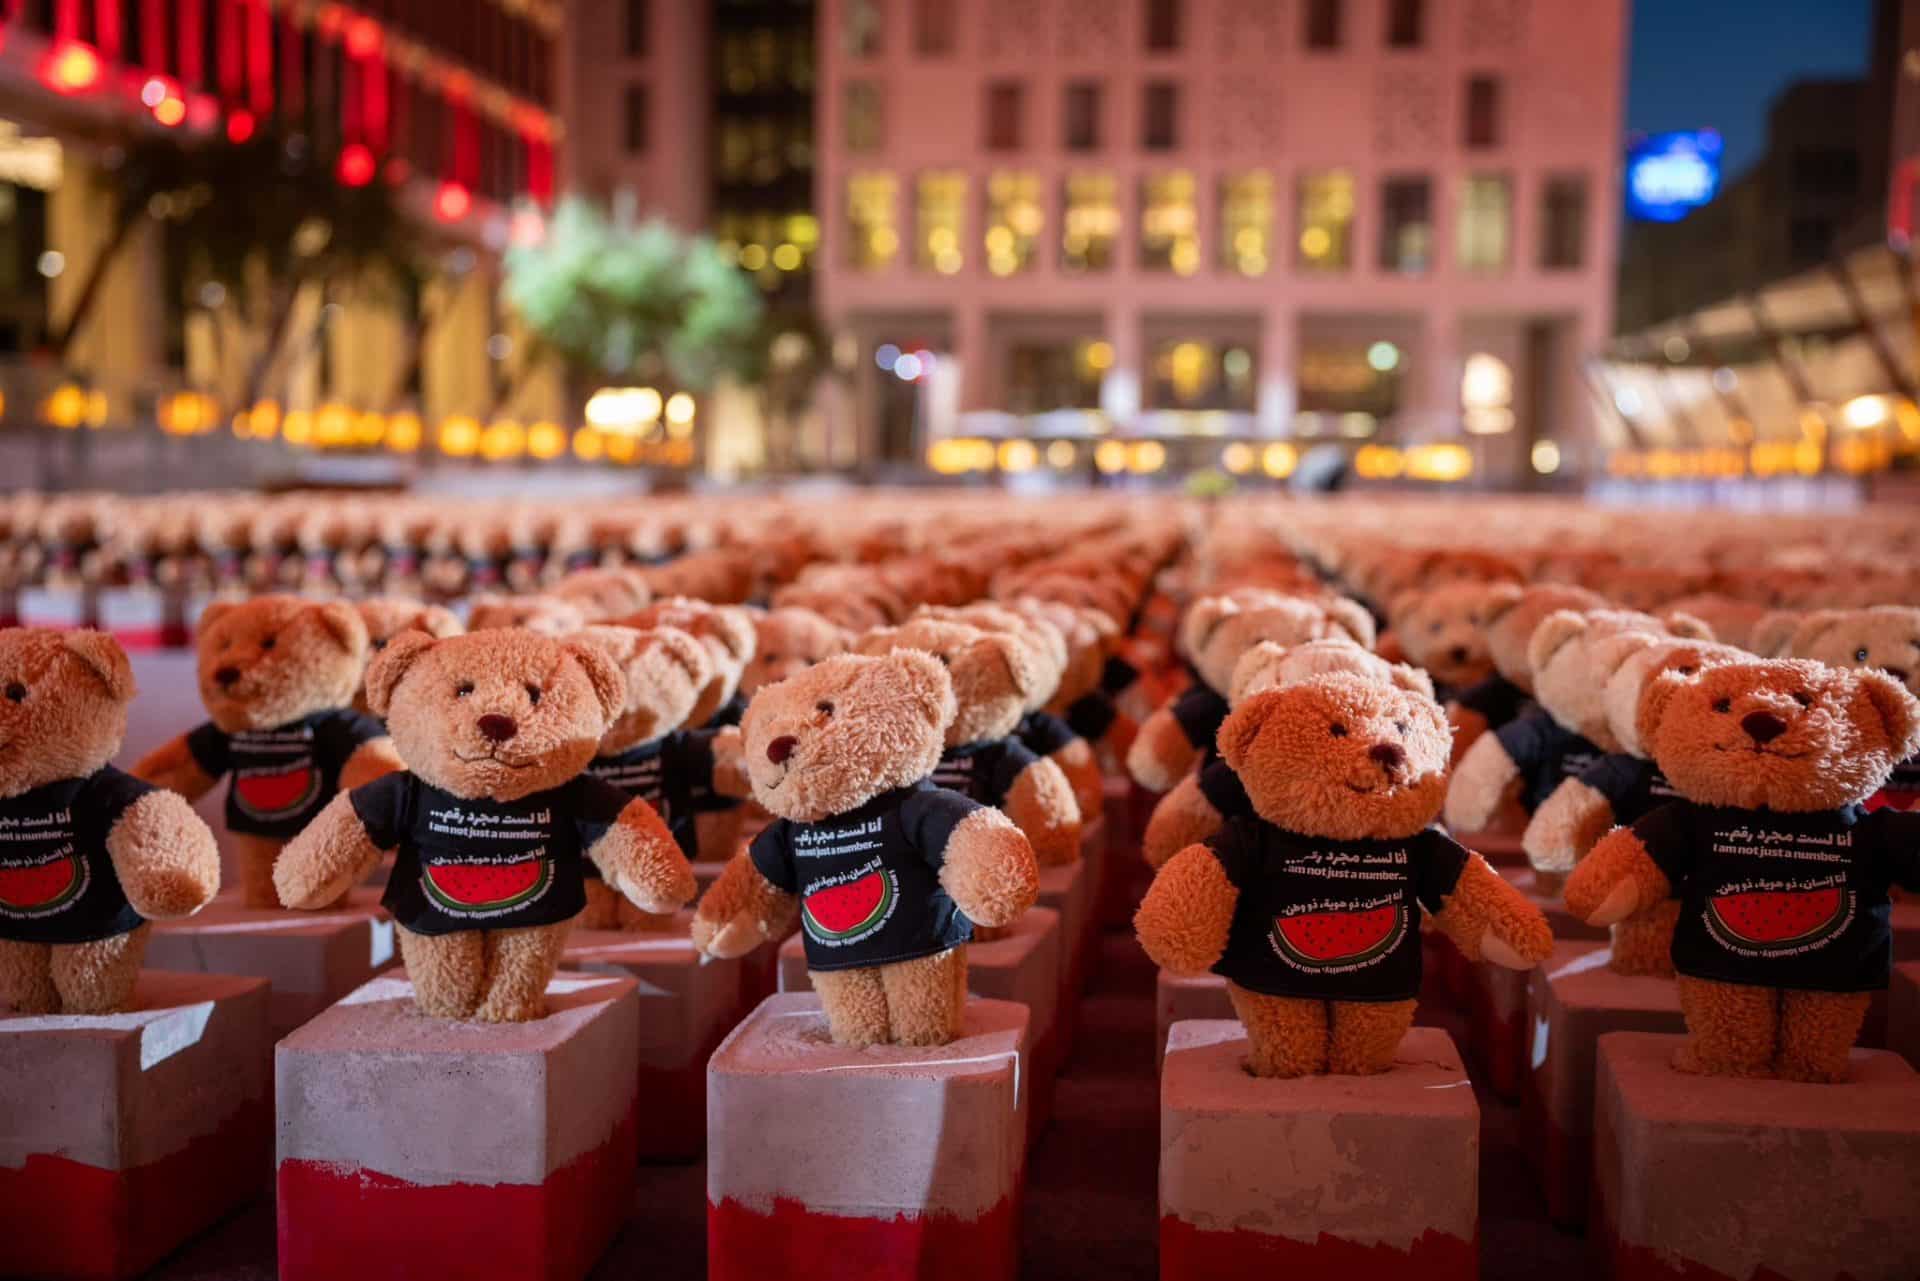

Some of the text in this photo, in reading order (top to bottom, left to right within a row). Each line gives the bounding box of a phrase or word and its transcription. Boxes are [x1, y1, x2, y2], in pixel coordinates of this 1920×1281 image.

[466, 812, 500, 827] مجرد
[502, 812, 535, 824] لست
[429, 821, 434, 831] I
[433, 824, 449, 833] am
[450, 825, 467, 836] not
[467, 827, 490, 839] just
[490, 831, 498, 839] a
[1757, 829, 1793, 845] مجرد
[1796, 832, 1834, 846] لست
[1836, 830, 1852, 847] أنا
[1325, 851, 1360, 866] مجرد
[1362, 851, 1392, 864] لست
[1394, 848, 1408, 864] أنا
[1712, 843, 1852, 863] I am not just a number...
[1288, 866, 1306, 874] am
[1307, 866, 1327, 877] not
[1326, 866, 1350, 880] just
[1350, 871, 1357, 879] a
